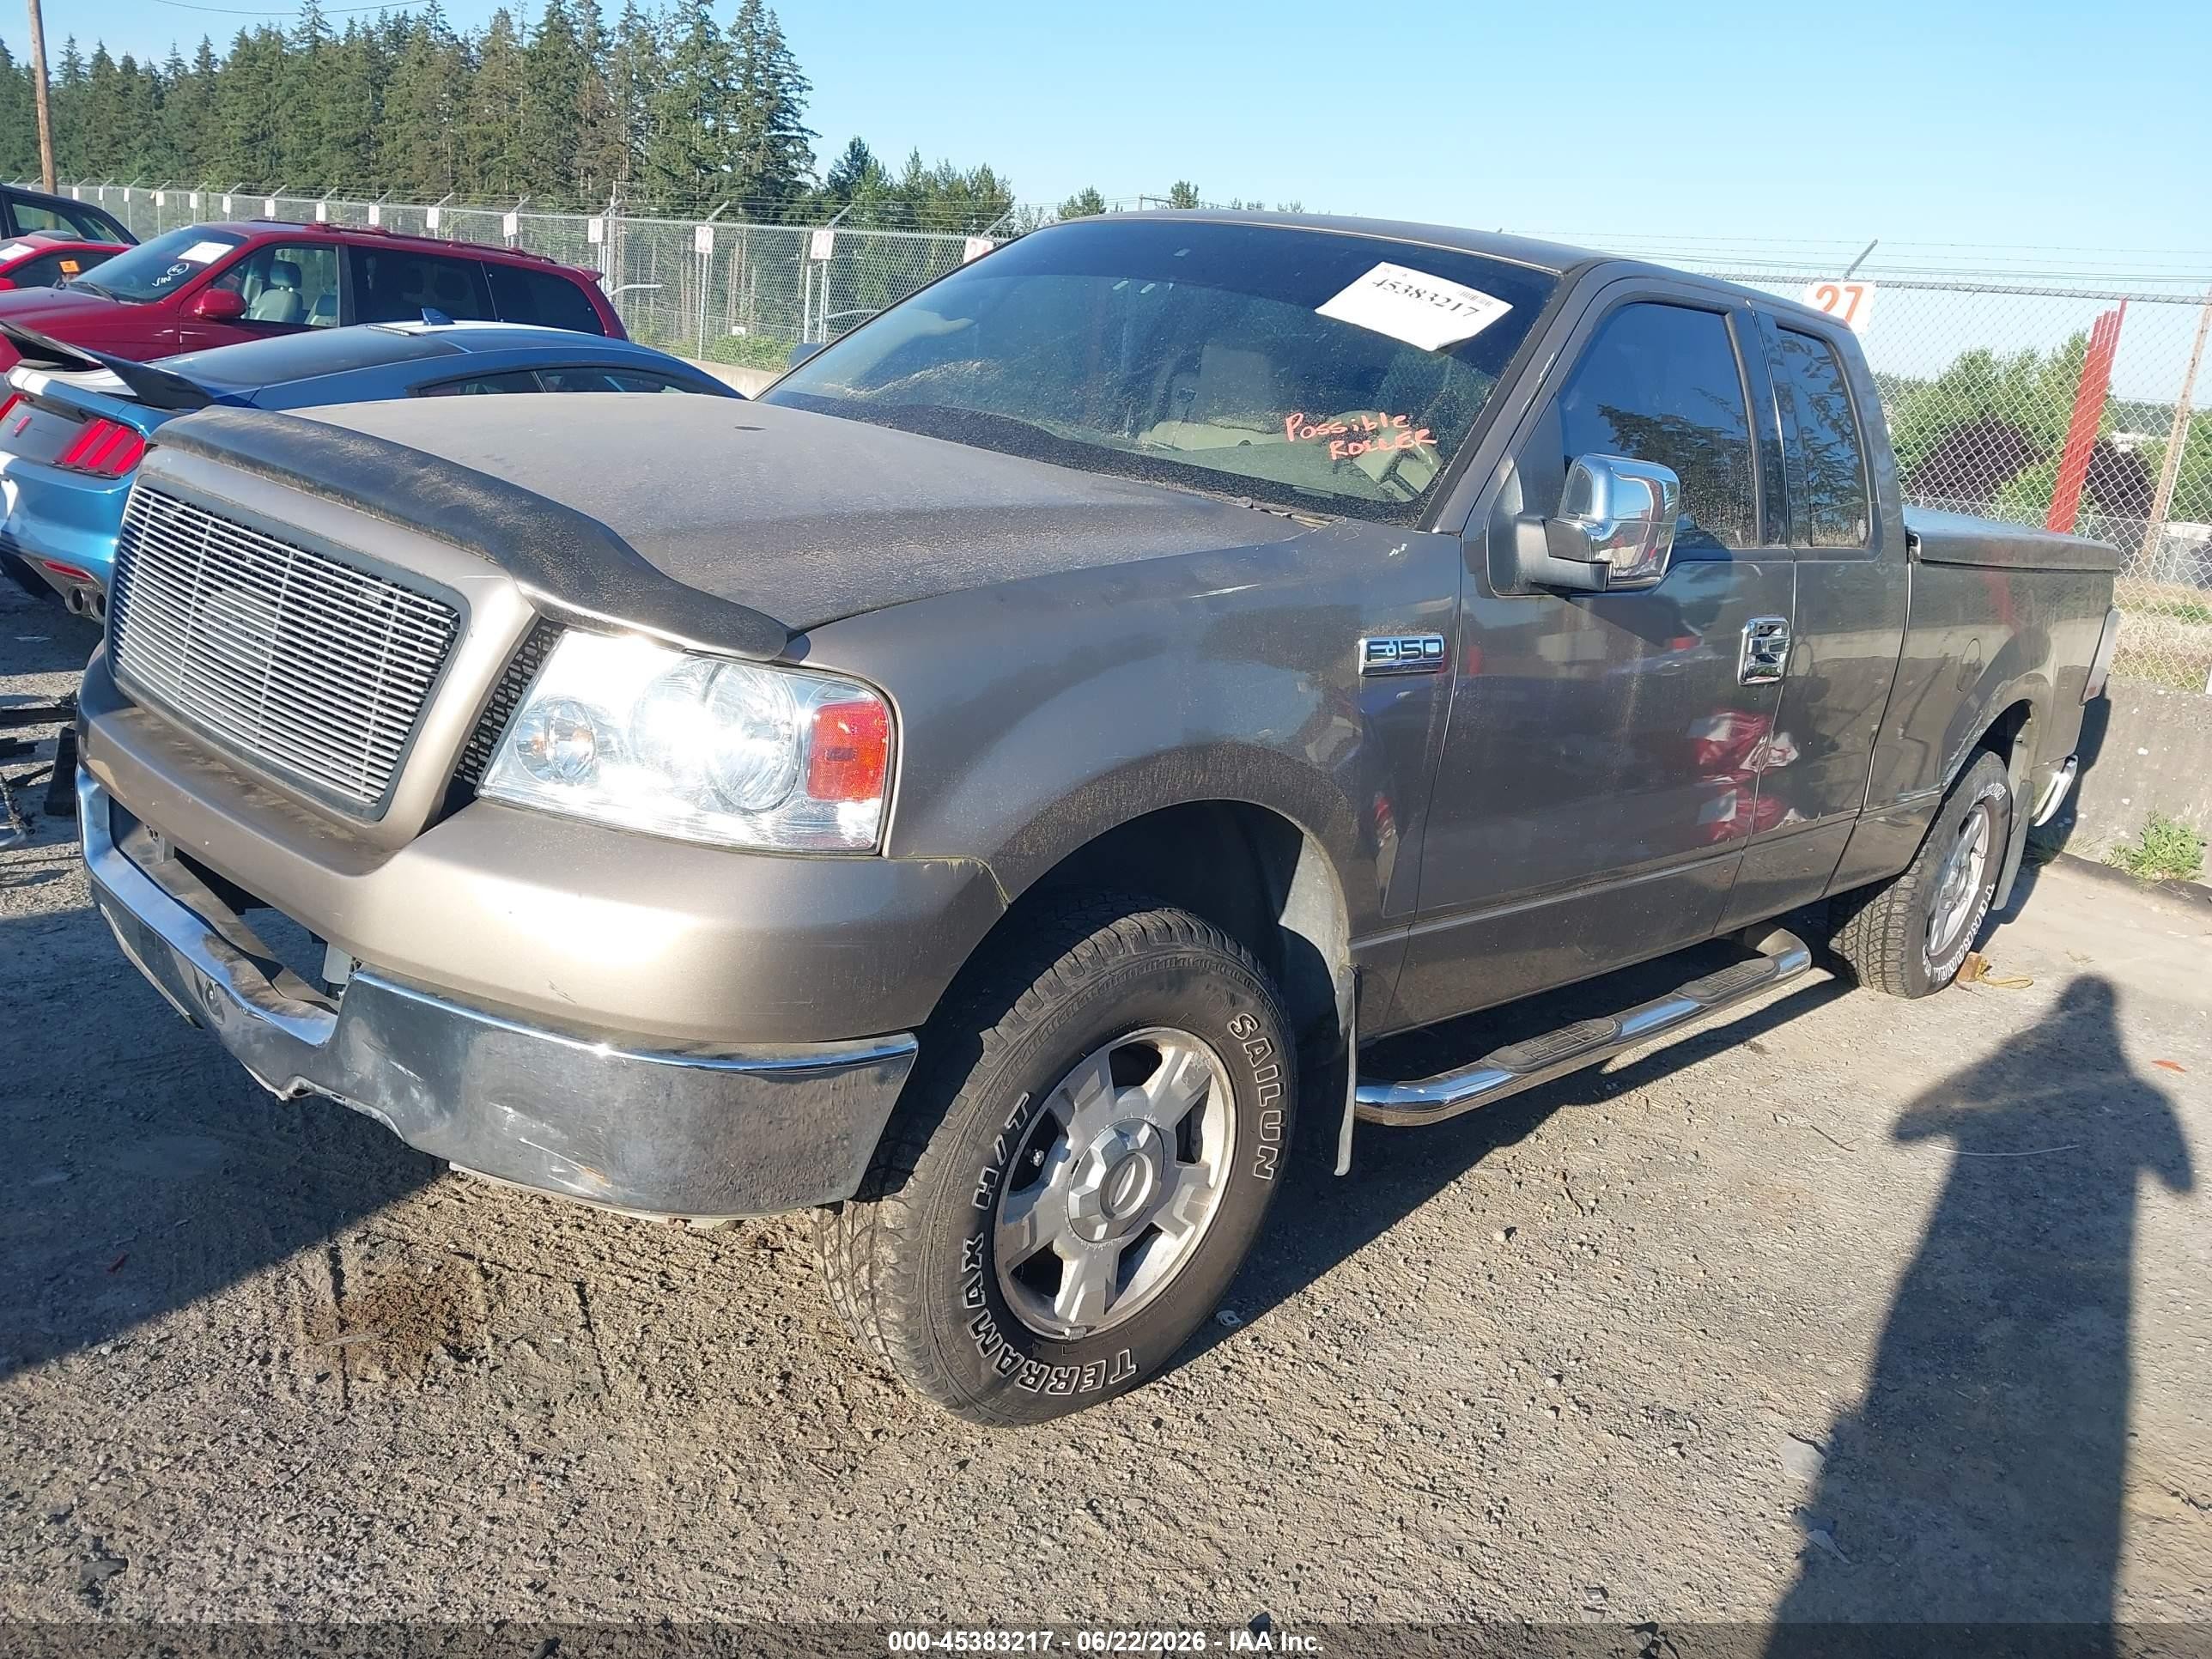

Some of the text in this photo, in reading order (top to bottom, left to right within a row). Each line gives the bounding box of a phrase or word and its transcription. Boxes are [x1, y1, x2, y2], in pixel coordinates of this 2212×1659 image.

[699, 228, 711, 252] 22
[1372, 278, 1480, 317] 45383217
[1815, 284, 1863, 323] 27
[1227, 1012, 1282, 1180] SAILUN
[961, 1091, 1138, 1395] TERRAMAX H/T
